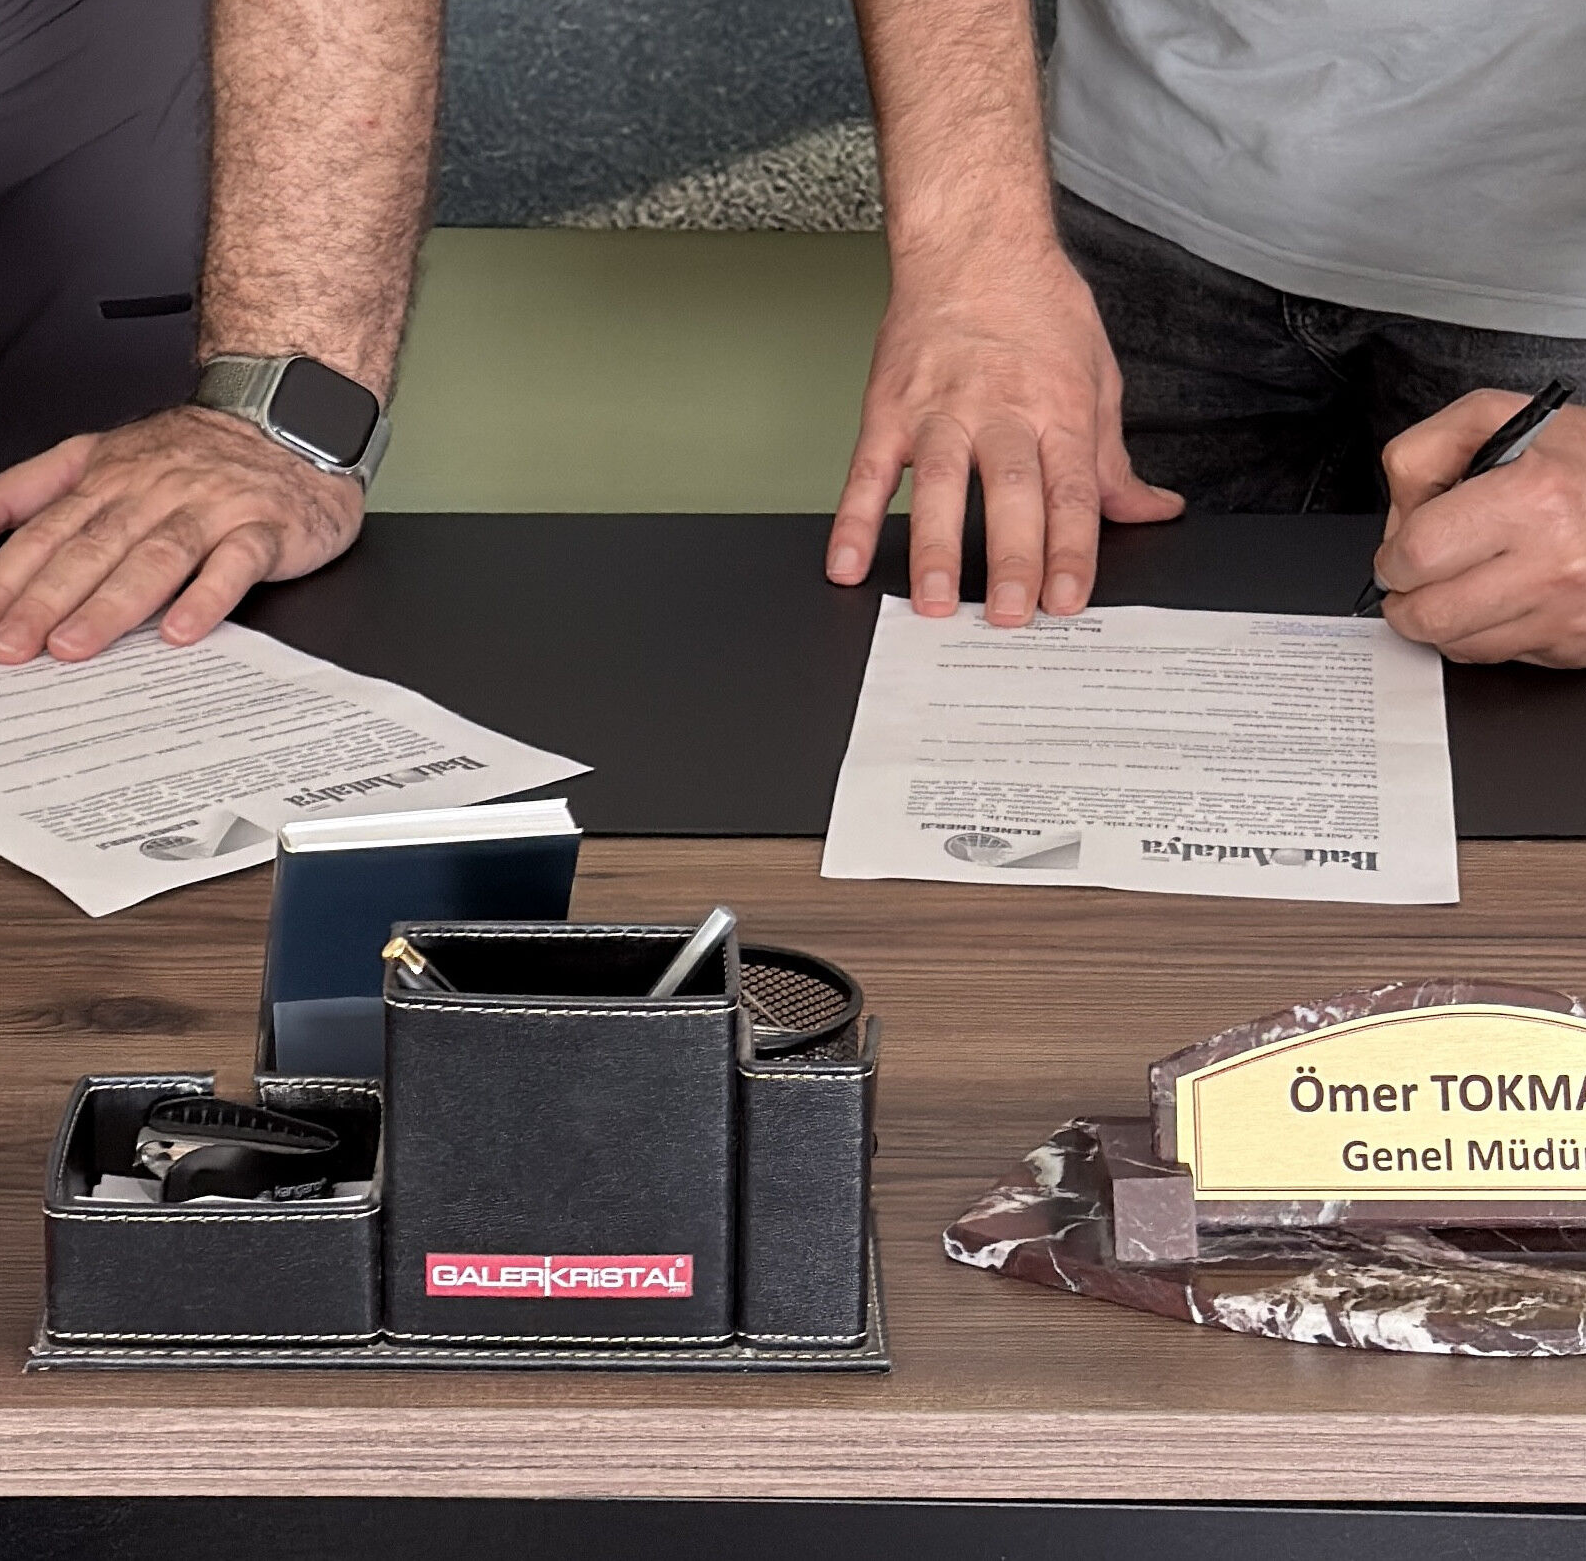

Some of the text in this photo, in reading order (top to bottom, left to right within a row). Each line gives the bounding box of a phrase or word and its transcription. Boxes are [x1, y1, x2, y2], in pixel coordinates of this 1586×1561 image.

[283, 773, 406, 808] Antalya
[1140, 836, 1380, 872] Batı Antalya
[1290, 1066, 1418, 1113] Ömer
[1342, 1138, 1453, 1172] Genel
